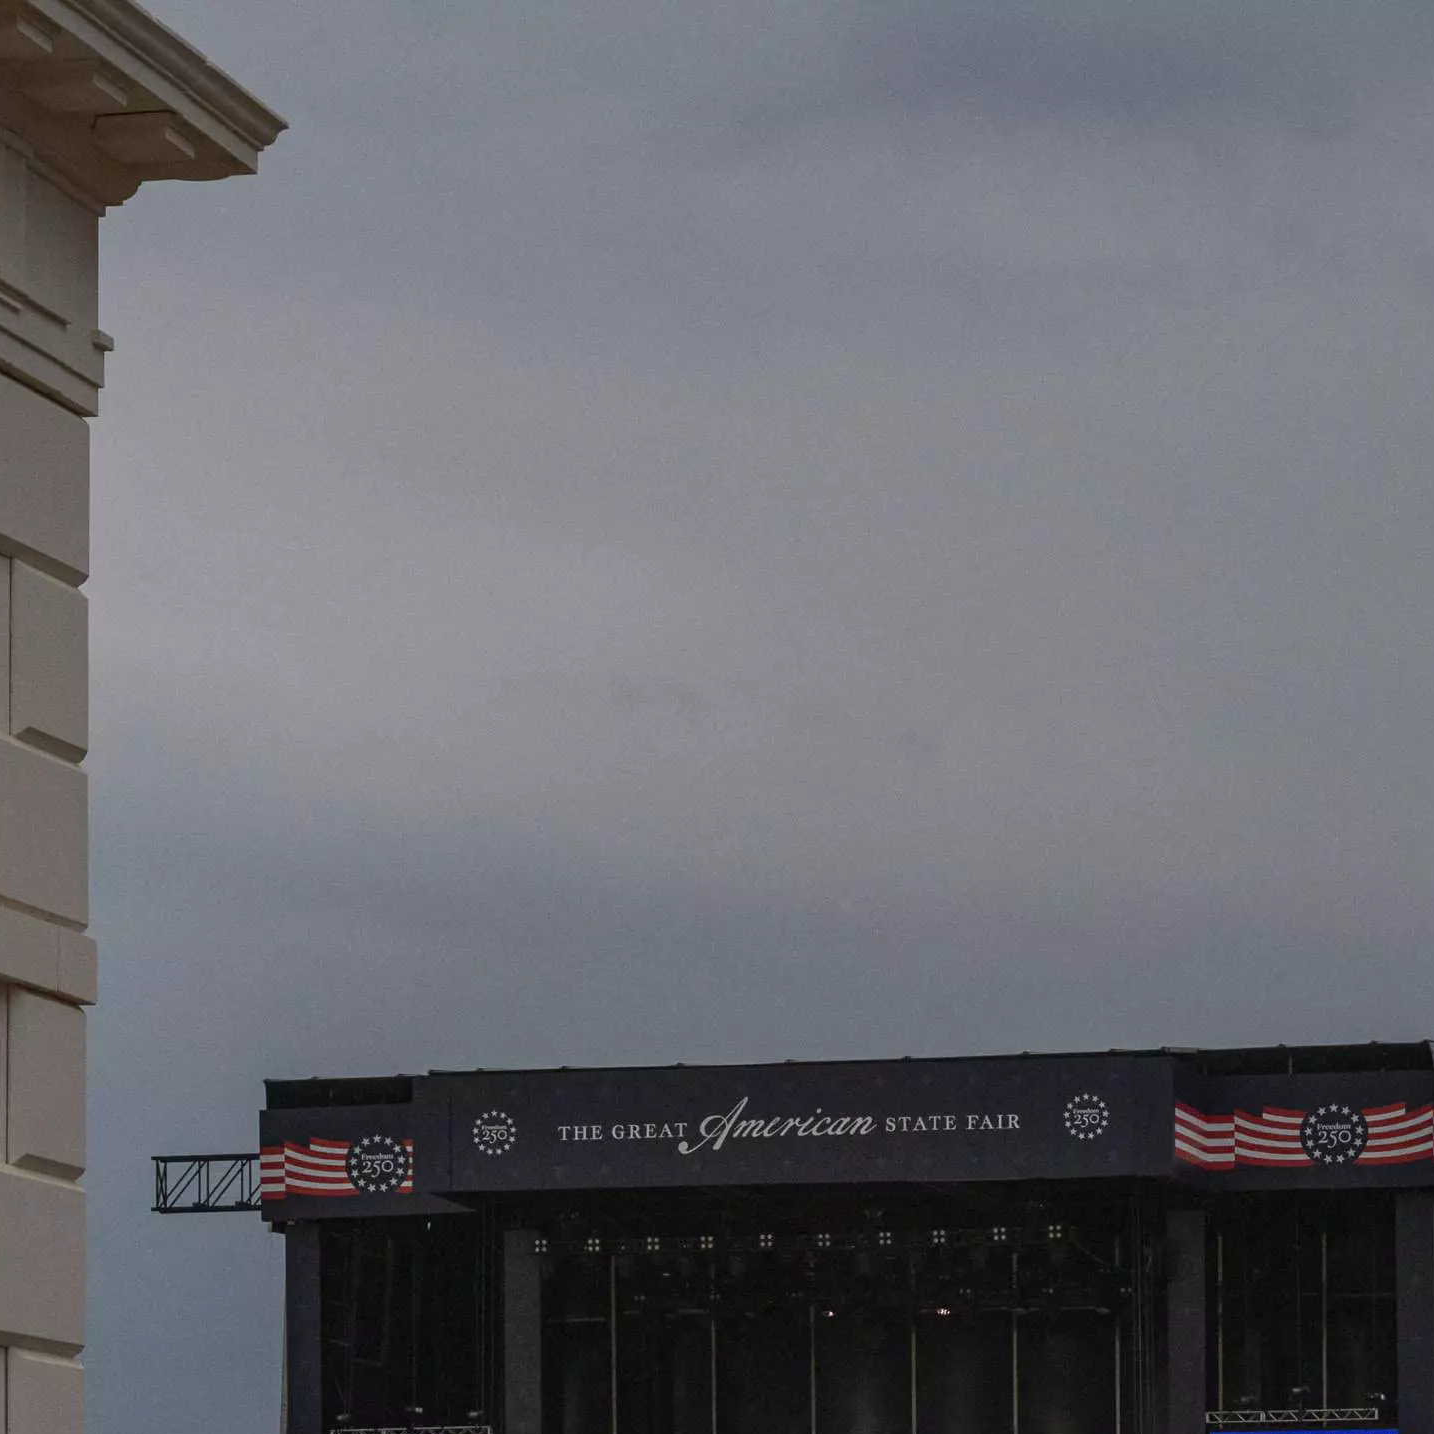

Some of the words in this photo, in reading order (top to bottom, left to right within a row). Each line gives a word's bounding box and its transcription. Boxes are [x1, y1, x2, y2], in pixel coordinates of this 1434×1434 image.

[557, 1125, 604, 1141] THE
[611, 1123, 688, 1139] GREAT
[678, 1096, 877, 1155] American
[885, 1115, 957, 1132] STATE
[966, 1114, 1021, 1130] FAIR
[1073, 1114, 1100, 1128] 250
[1317, 1122, 1352, 1130] Freedom
[482, 1130, 508, 1144] 250
[1318, 1130, 1352, 1148] 250
[361, 1152, 394, 1161] Freedom
[361, 1160, 395, 1178] 250
